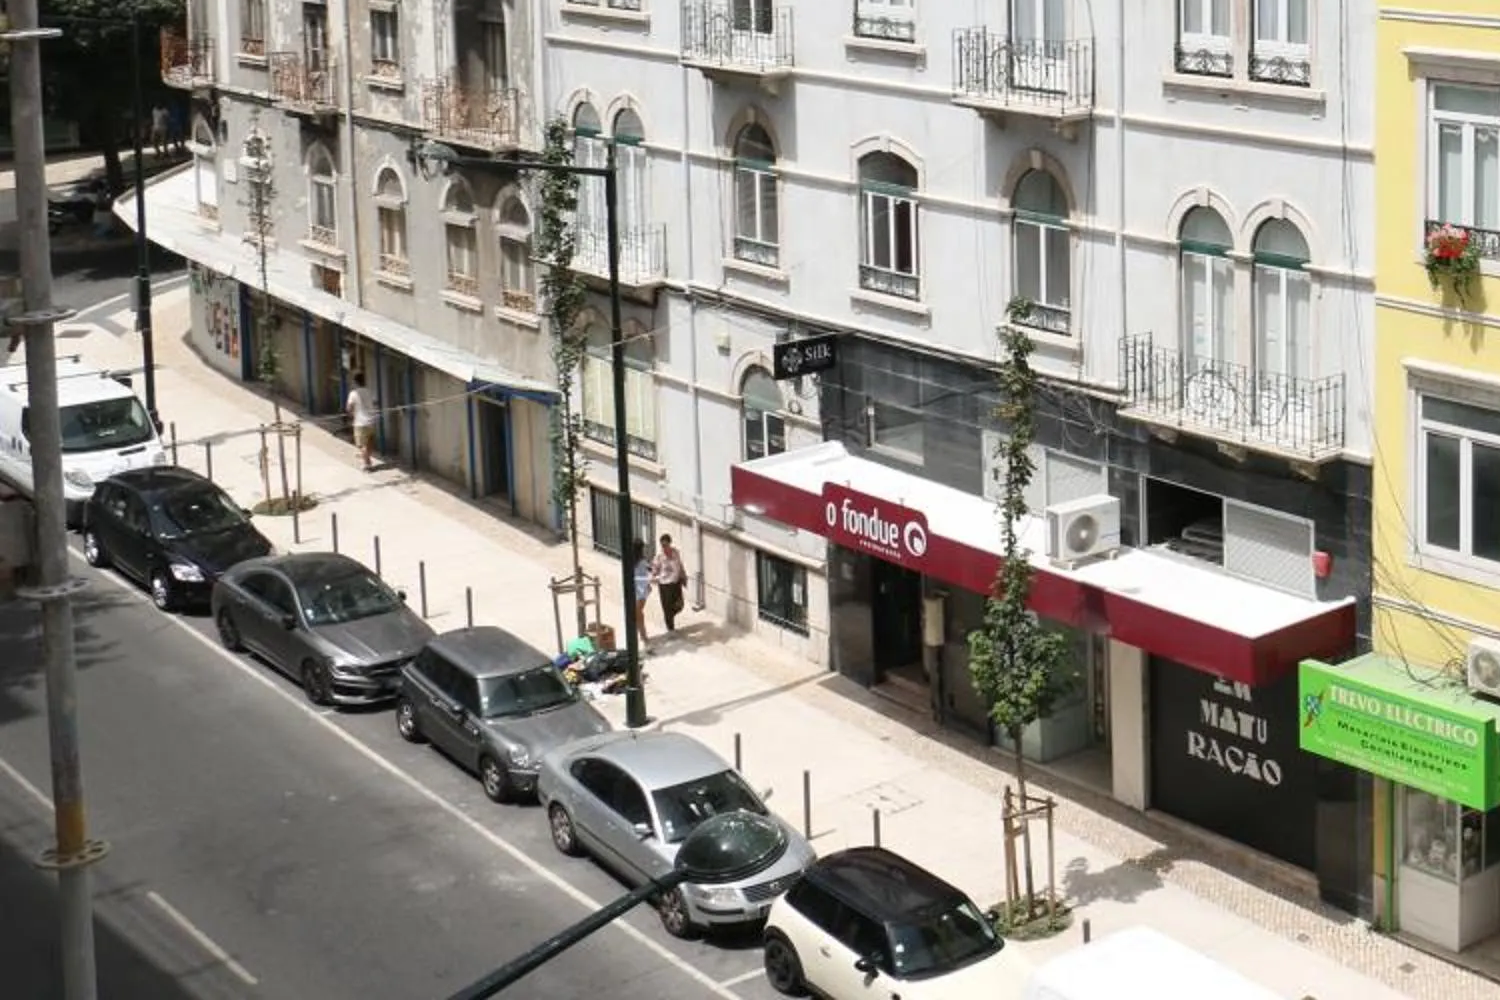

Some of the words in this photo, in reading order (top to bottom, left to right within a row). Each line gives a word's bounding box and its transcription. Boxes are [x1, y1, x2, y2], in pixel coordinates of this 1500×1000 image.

[842, 498, 899, 549] fondue
[1200, 699, 1267, 744] MATU
[1330, 685, 1381, 715] TREVO
[1187, 730, 1282, 786] RAÇÃO
